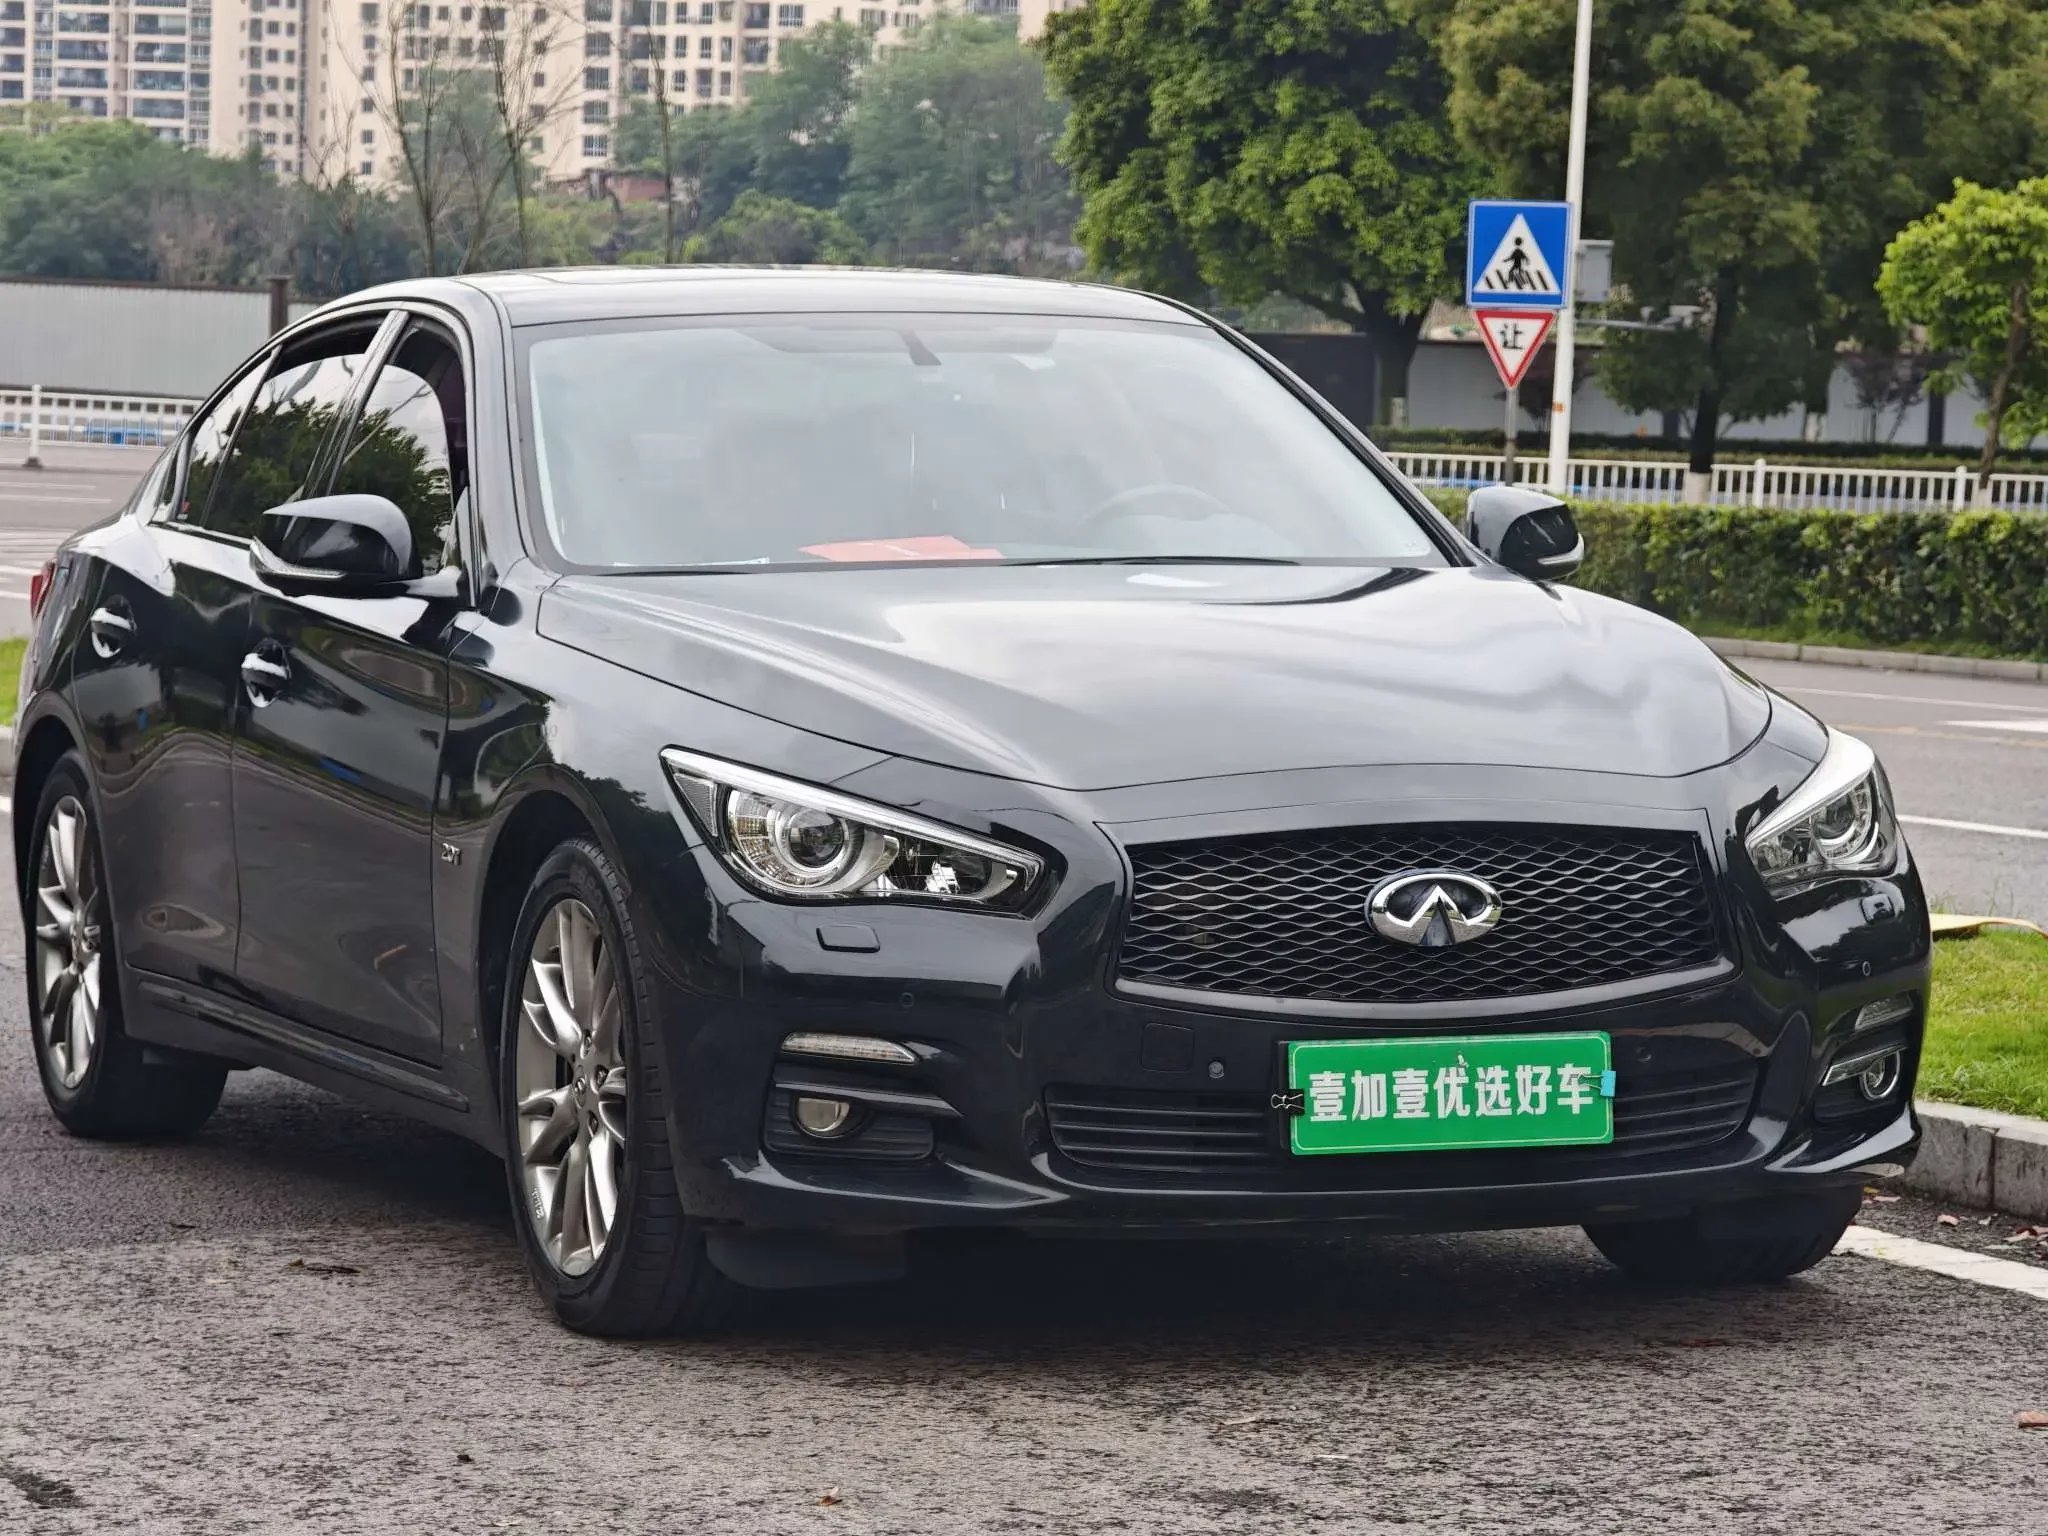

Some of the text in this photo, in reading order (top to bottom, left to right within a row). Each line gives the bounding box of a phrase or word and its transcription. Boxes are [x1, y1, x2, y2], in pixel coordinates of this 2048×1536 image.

[1498, 323, 1523, 350] 让
[1308, 1058, 1593, 1122] 壹加壹优选好车
